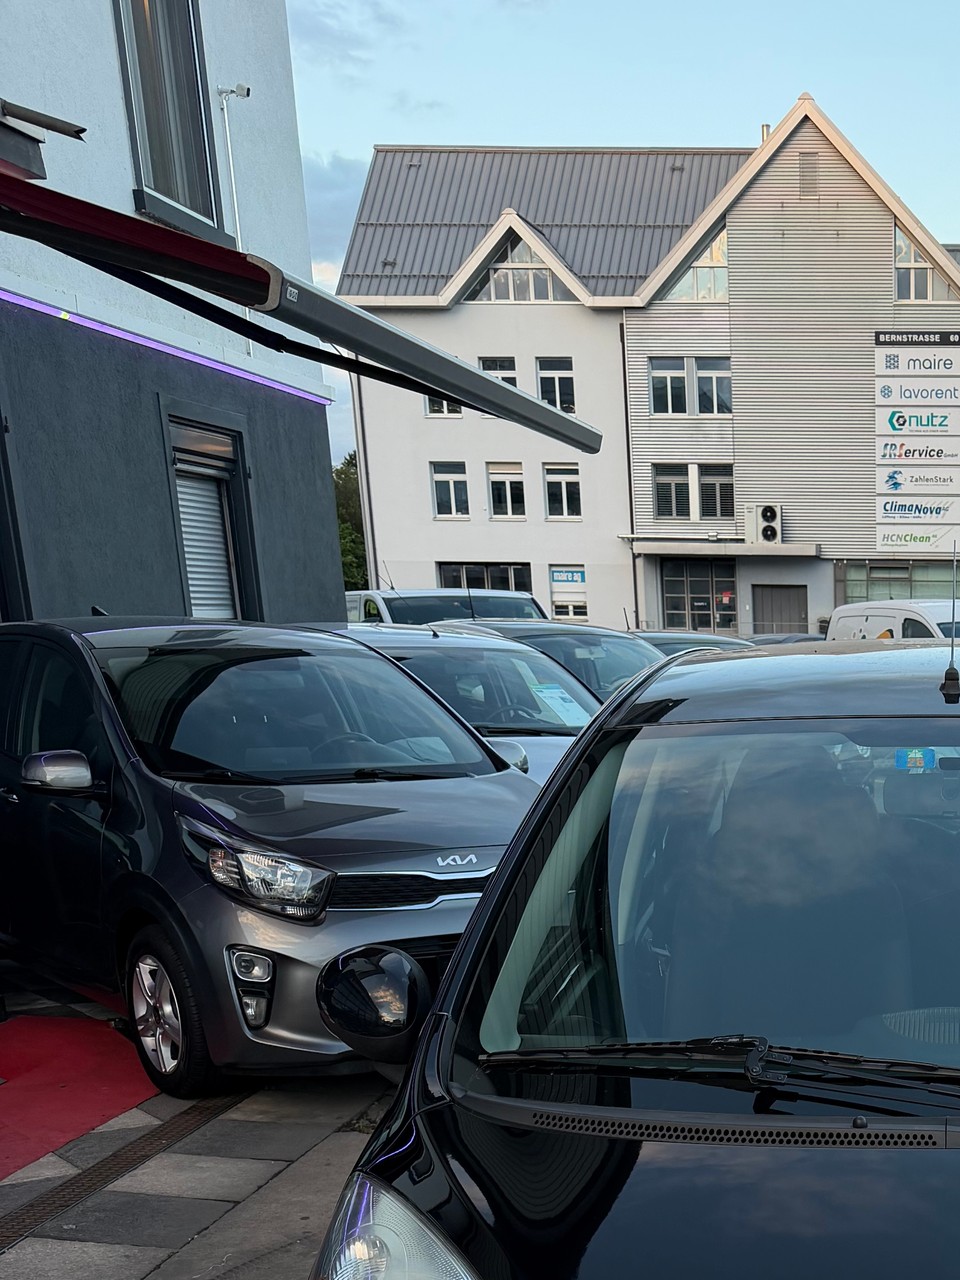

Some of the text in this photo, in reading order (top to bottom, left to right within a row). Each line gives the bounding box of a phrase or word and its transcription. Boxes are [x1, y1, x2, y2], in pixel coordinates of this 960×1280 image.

[879, 334, 959, 342] BERNSTRASSE 60
[907, 353, 953, 370] maire
[899, 384, 959, 399] lavorent
[908, 412, 949, 427] nutz
[909, 475, 954, 483] ZahlenStark
[883, 501, 942, 515] ClimaNova
[882, 533, 931, 542] HCNClean
